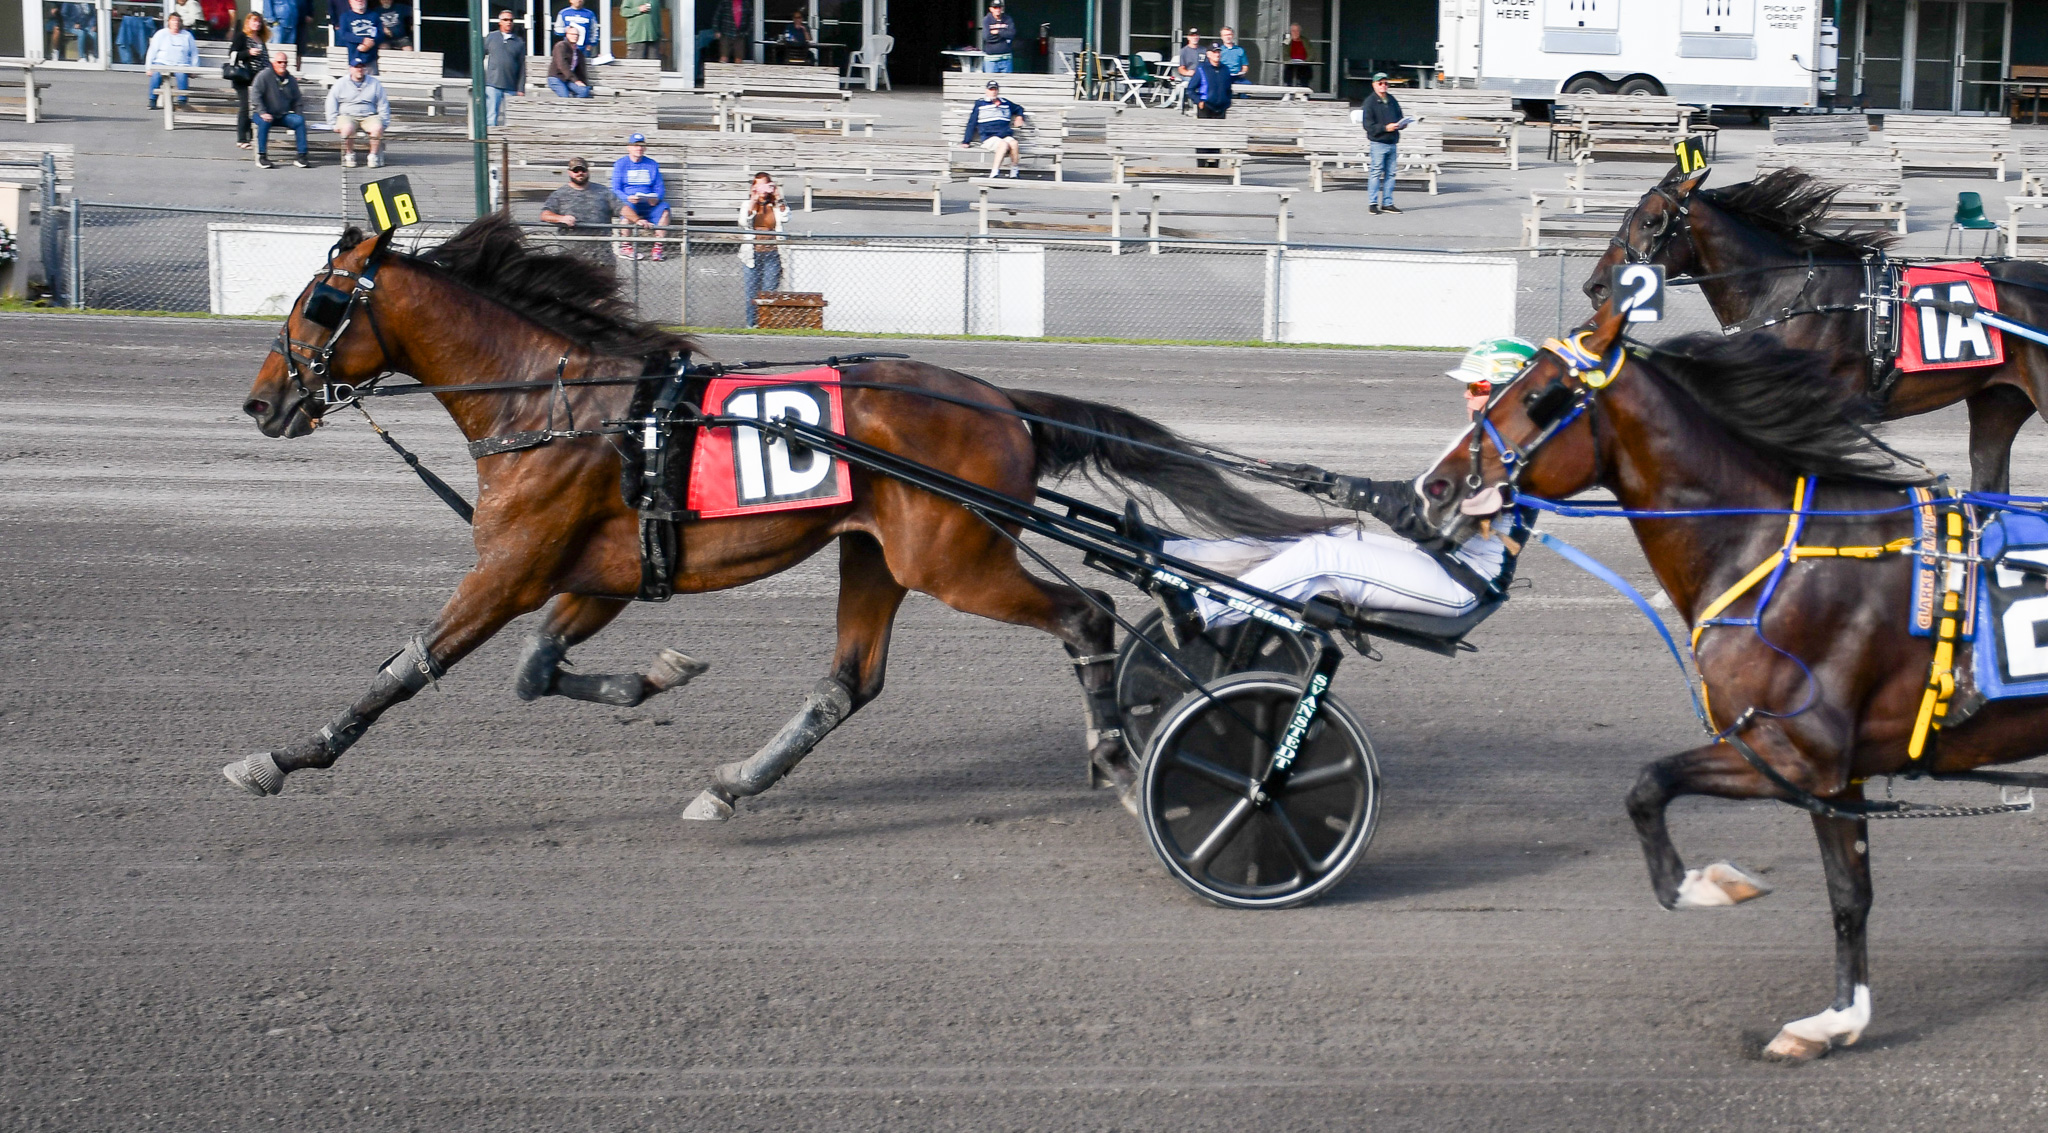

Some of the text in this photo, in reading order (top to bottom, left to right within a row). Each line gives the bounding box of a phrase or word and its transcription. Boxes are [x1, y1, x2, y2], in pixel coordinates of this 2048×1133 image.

[1497, 9, 1530, 19] HERE
[1620, 264, 1658, 322] 2
[1913, 285, 1991, 360] 1A
[1917, 570, 1936, 630] CLARKE
[1275, 674, 1328, 769] SVANSTEDT
